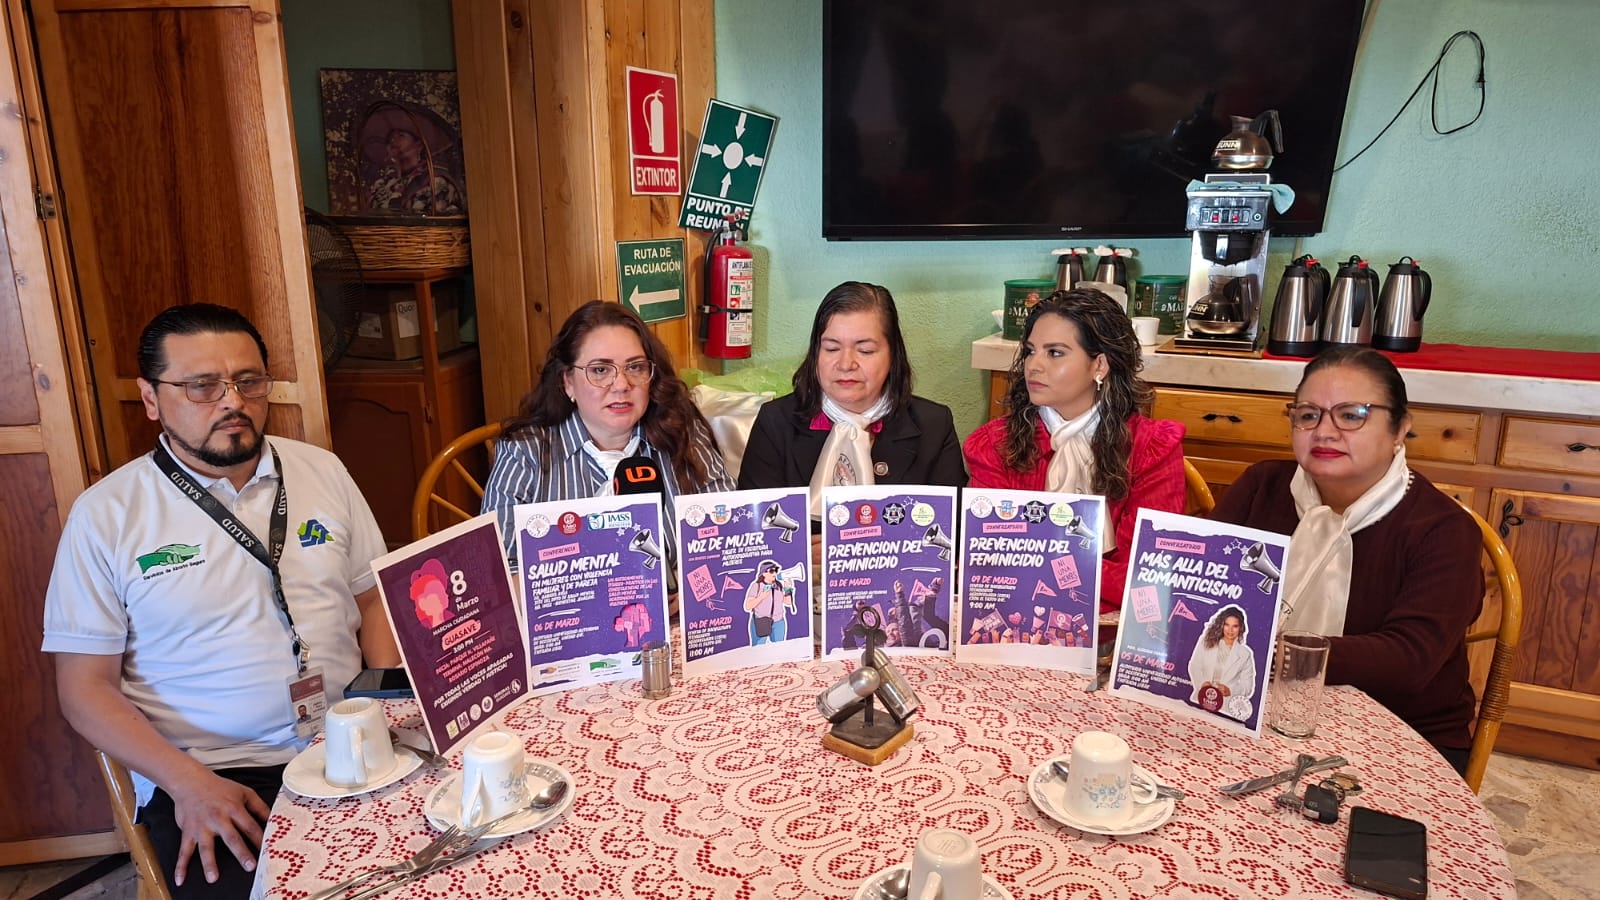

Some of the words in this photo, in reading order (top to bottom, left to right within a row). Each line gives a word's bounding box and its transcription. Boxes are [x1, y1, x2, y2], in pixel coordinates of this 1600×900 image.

[636, 167, 677, 186] EXTINTOR
[687, 197, 731, 216] PUNTO
[634, 248, 658, 260] RUTA
[660, 247, 671, 258] DE
[624, 259, 680, 276] EVACUACIÓN
[170, 472, 202, 500] SALUD
[608, 513, 630, 522] IMSS
[222, 518, 255, 548] SALUD
[543, 546, 576, 557] CONFERENCIA
[688, 539, 708, 554] VOZ
[709, 537, 724, 551] DE
[725, 532, 764, 548] MUJER
[828, 540, 900, 559] PREVENCION
[902, 540, 922, 553] DEL
[969, 537, 1047, 552] PREVENCION
[1048, 540, 1070, 554] DEL
[528, 560, 568, 580] SALUD
[570, 552, 620, 573] MENTAL
[828, 556, 898, 574] FEMINICIDIO
[969, 553, 1044, 567] FEMINICIDIO
[1139, 550, 1172, 568] MÁS
[1172, 556, 1201, 574] ALLA
[1204, 562, 1229, 580] DEL
[450, 570, 467, 595] 8
[531, 581, 540, 589] EN
[541, 577, 568, 586] MUJERES
[584, 569, 613, 579] VIOLENCIA
[532, 584, 560, 596] FAMILIAR
[566, 582, 574, 590] DE
[575, 579, 598, 589] PAREJA
[848, 578, 871, 586] MARZO
[982, 576, 992, 584] DE
[1137, 567, 1242, 600] ROMANTICISMO
[456, 596, 479, 612] Marzo
[984, 602, 995, 610] AM
[433, 623, 453, 636] MARCHA
[453, 608, 480, 625] CIUDADANA
[534, 624, 543, 632] 06
[545, 621, 554, 630] DE
[555, 617, 580, 628] MARZO
[699, 620, 708, 628] DE
[709, 616, 732, 626] MARZO
[444, 624, 477, 645] GUASAVE
[703, 647, 714, 656] AM
[1121, 652, 1131, 661] 05
[1132, 655, 1144, 664] DE
[1146, 658, 1175, 671] MARZO
